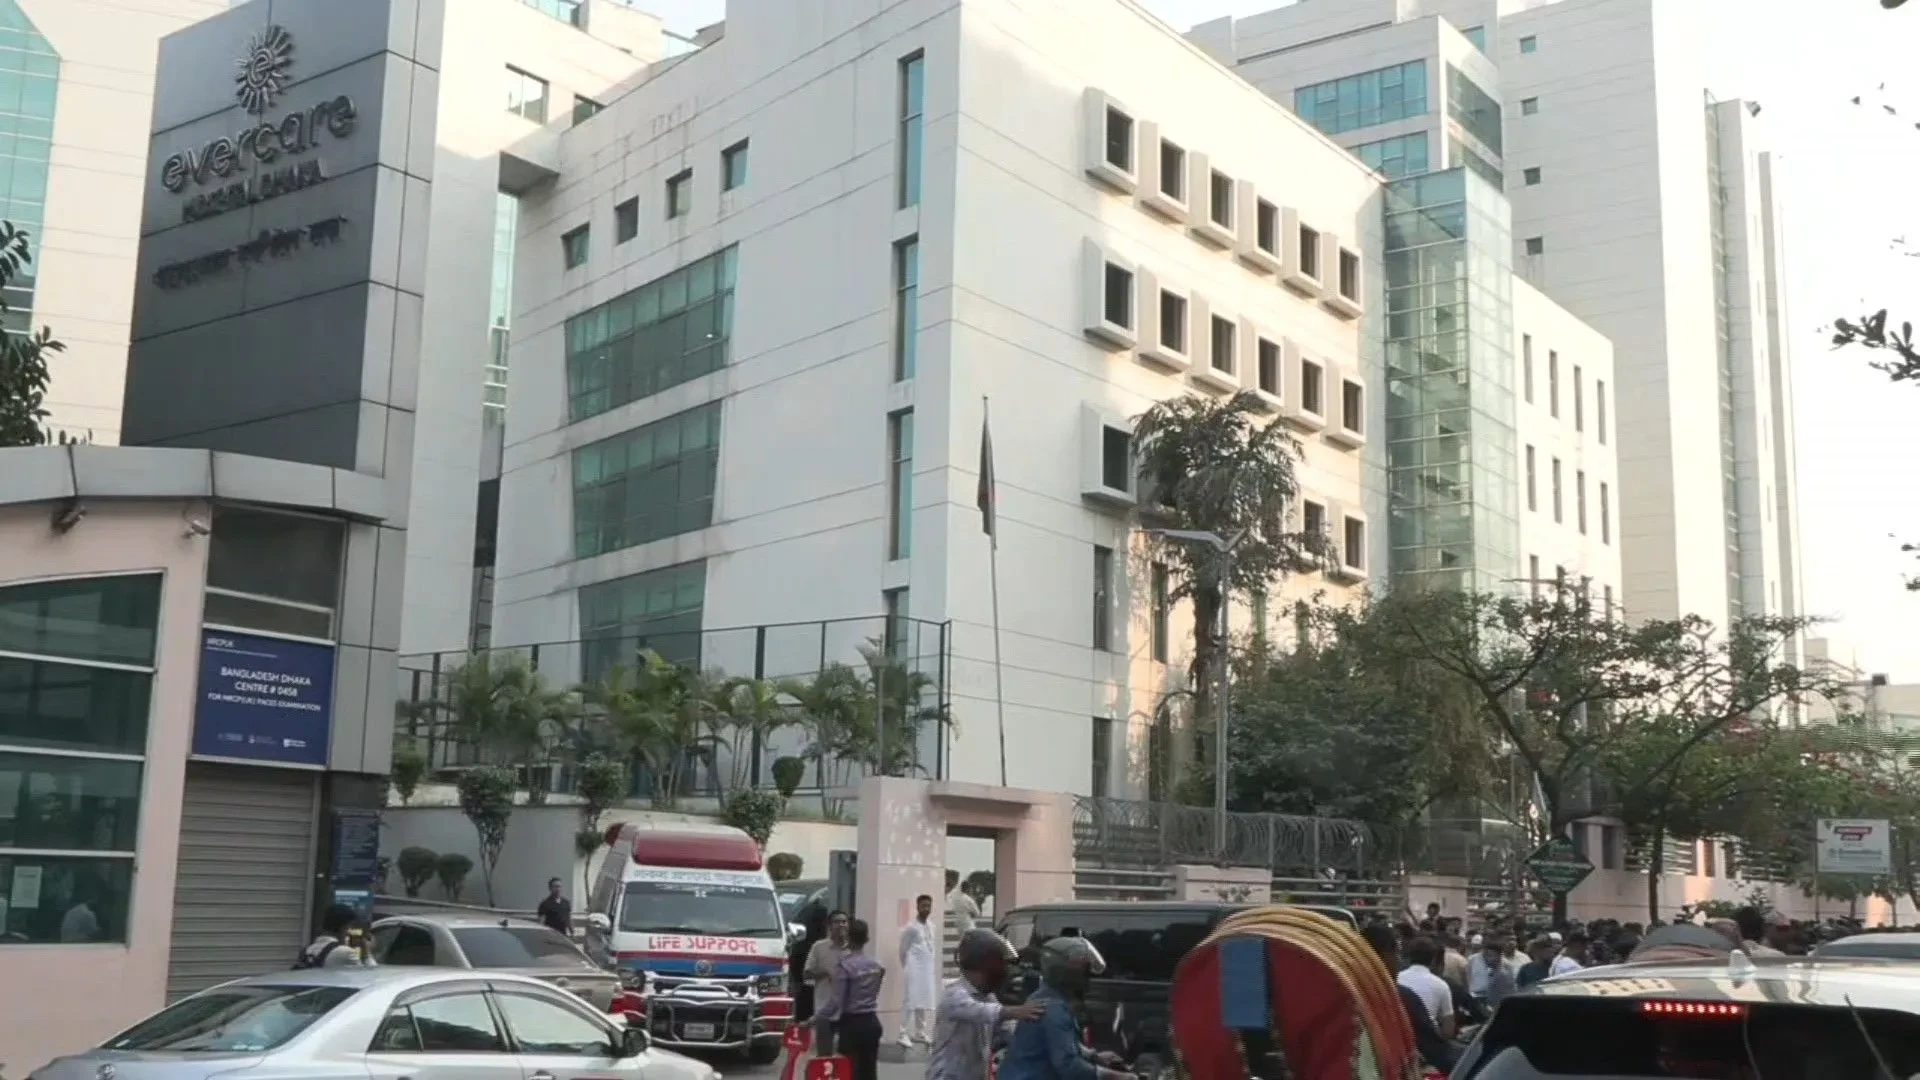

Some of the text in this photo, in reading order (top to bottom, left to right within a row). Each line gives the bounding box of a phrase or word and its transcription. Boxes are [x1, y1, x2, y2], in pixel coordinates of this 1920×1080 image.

[161, 95, 357, 193] evercare
[220, 666, 311, 686] BANGLADESH DHAKA
[234, 681, 268, 694] CENTRE
[208, 692, 221, 700] FOR
[278, 702, 321, 712] EXAMINATION
[649, 935, 757, 954] LIFE SUPPORT
